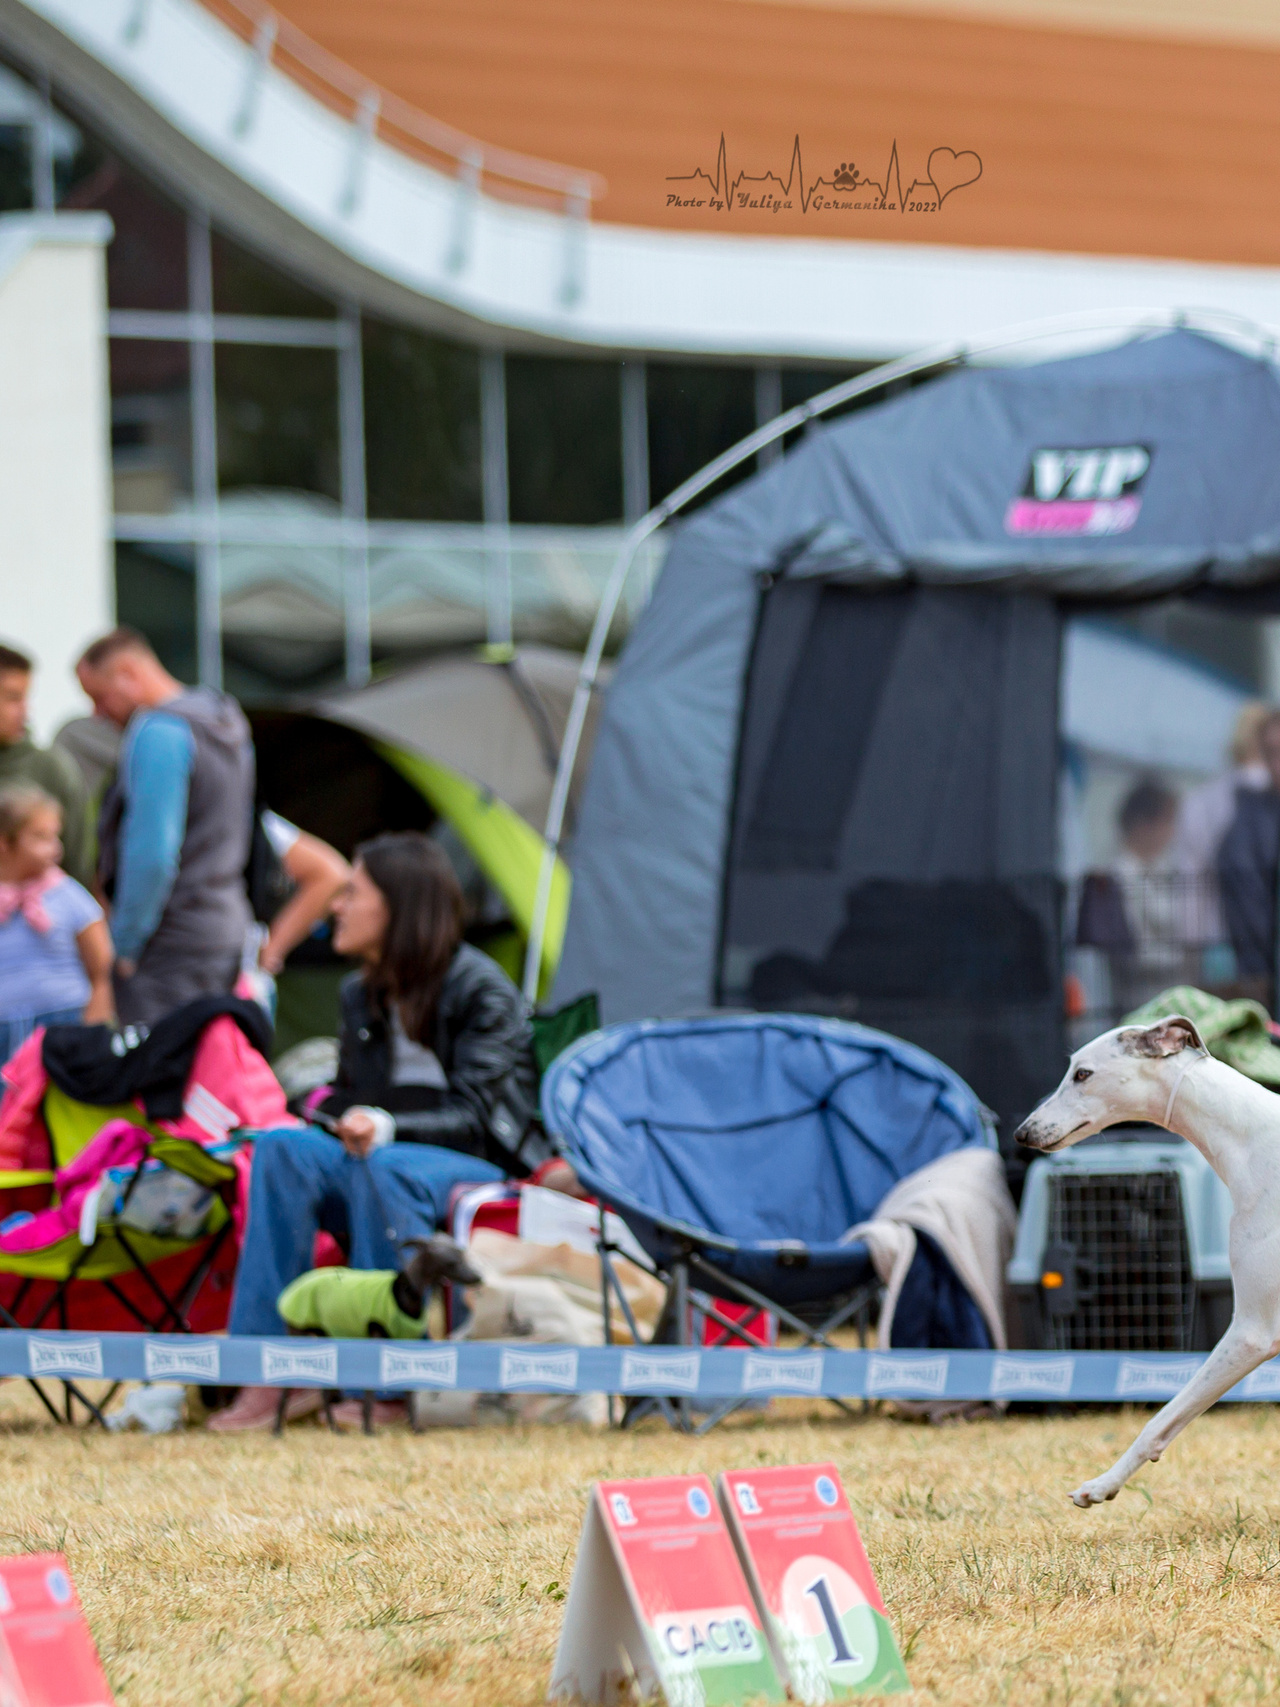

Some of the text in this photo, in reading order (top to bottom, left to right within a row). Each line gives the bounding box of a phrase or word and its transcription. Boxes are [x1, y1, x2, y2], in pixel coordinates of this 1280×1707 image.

[1033, 446, 1150, 501] VIP
[664, 1616, 754, 1658] CACIB
[805, 1574, 862, 1666] 1
